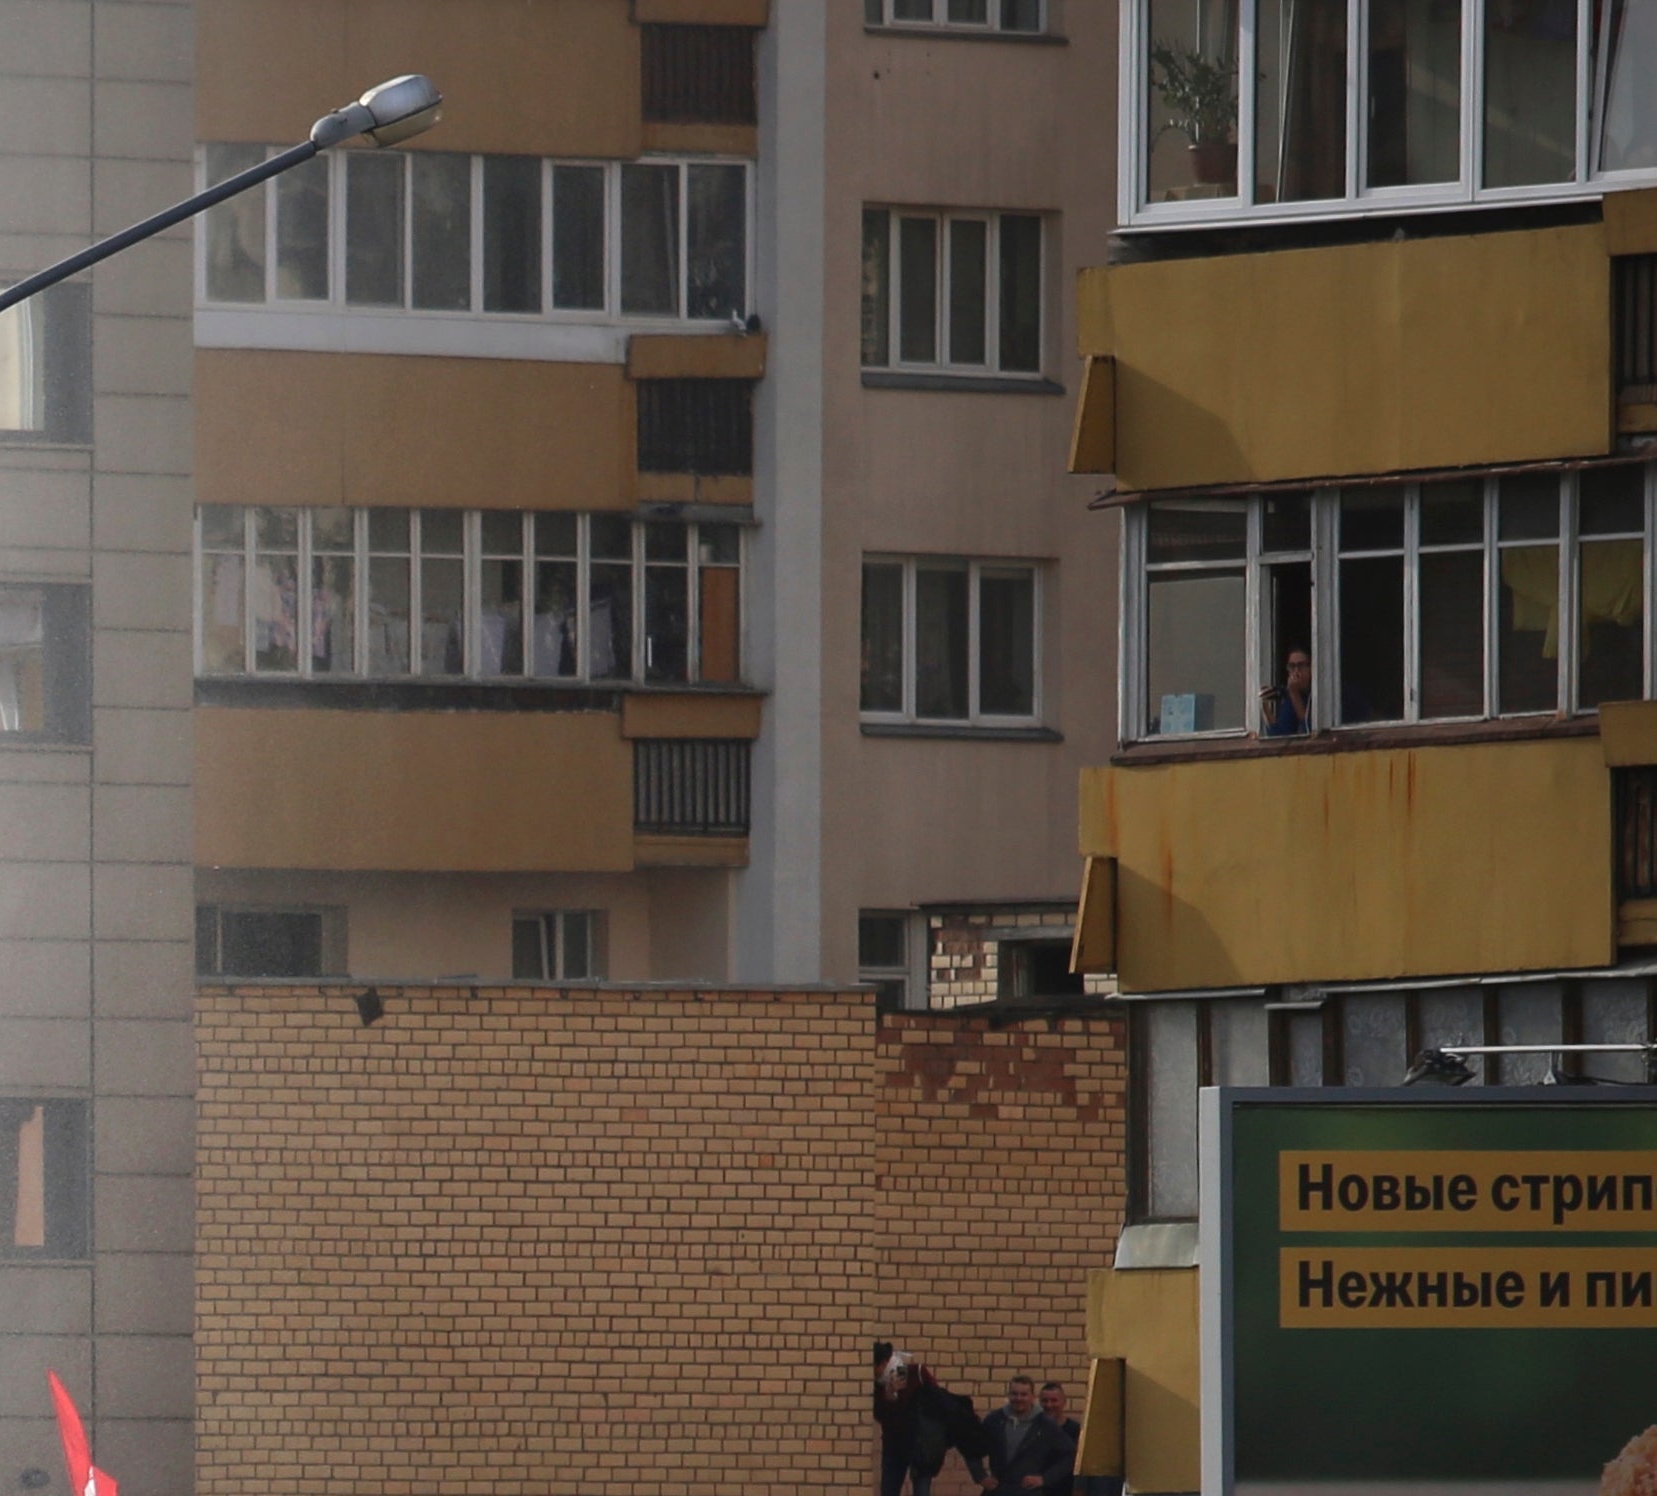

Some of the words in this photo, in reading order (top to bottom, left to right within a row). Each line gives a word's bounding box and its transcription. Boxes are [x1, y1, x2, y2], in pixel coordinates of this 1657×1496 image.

[1297, 1162, 1478, 1212] Новые
[1491, 1173, 1657, 1225] стрип
[1297, 1260, 1525, 1309] Нежные
[1539, 1271, 1571, 1308] и
